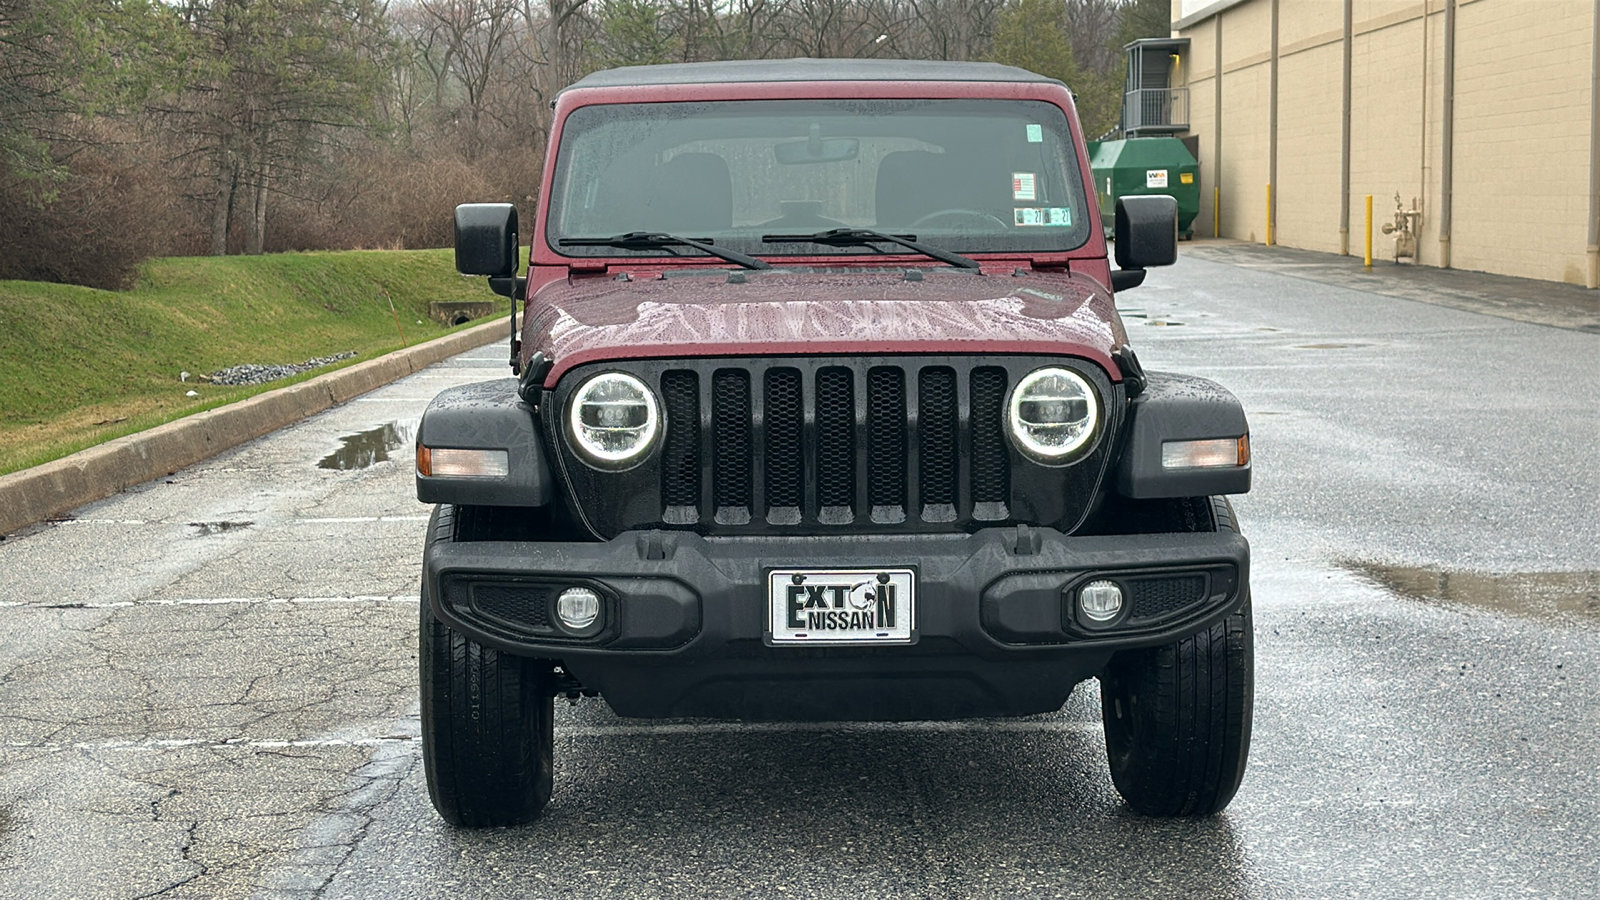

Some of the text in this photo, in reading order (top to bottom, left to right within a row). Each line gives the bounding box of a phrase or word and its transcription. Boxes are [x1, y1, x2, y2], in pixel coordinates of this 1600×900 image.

[1035, 210, 1042, 223] 27
[1062, 209, 1069, 223] 27
[808, 611, 874, 630] NISSAN
